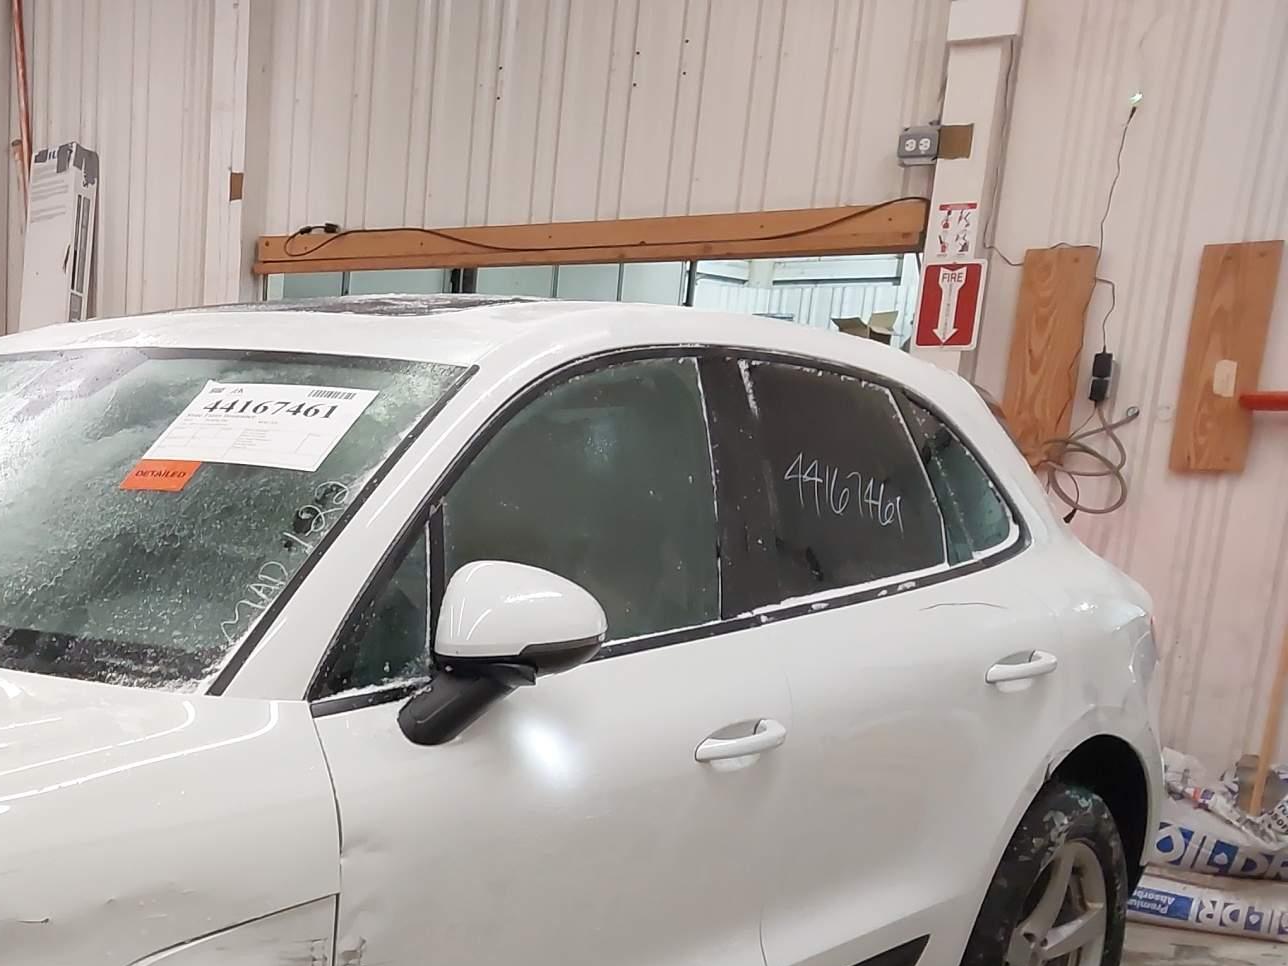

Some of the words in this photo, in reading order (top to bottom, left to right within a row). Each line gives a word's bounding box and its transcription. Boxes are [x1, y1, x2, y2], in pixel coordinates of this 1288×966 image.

[942, 272, 963, 283] FIRE
[202, 399, 339, 419] 44167461
[135, 469, 187, 479] DETAILED
[783, 452, 904, 535] 44167461
[220, 561, 290, 643] MAD
